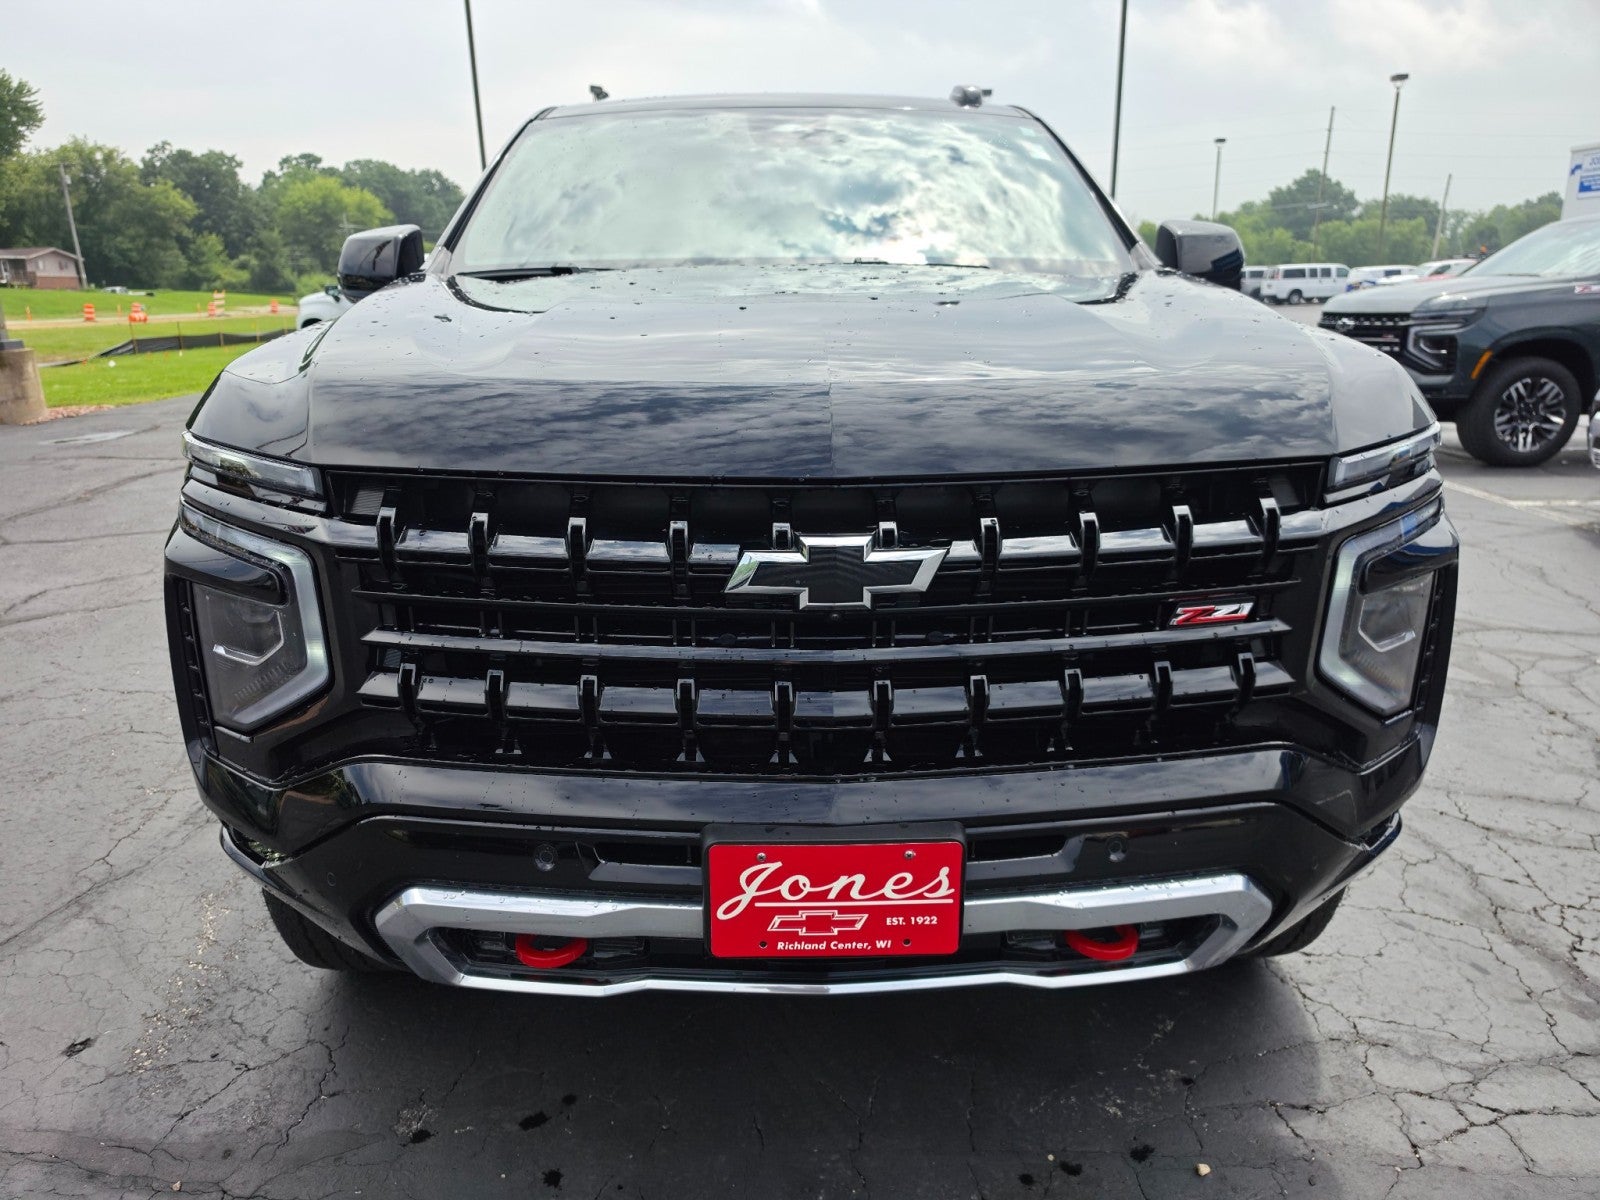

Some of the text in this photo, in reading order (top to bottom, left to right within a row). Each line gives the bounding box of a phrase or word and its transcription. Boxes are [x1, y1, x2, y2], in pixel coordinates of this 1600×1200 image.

[1169, 602, 1253, 625] Z71
[716, 861, 955, 920] Jones
[886, 915, 938, 926] EST. 1922
[777, 939, 892, 950] Richland Center, WI
